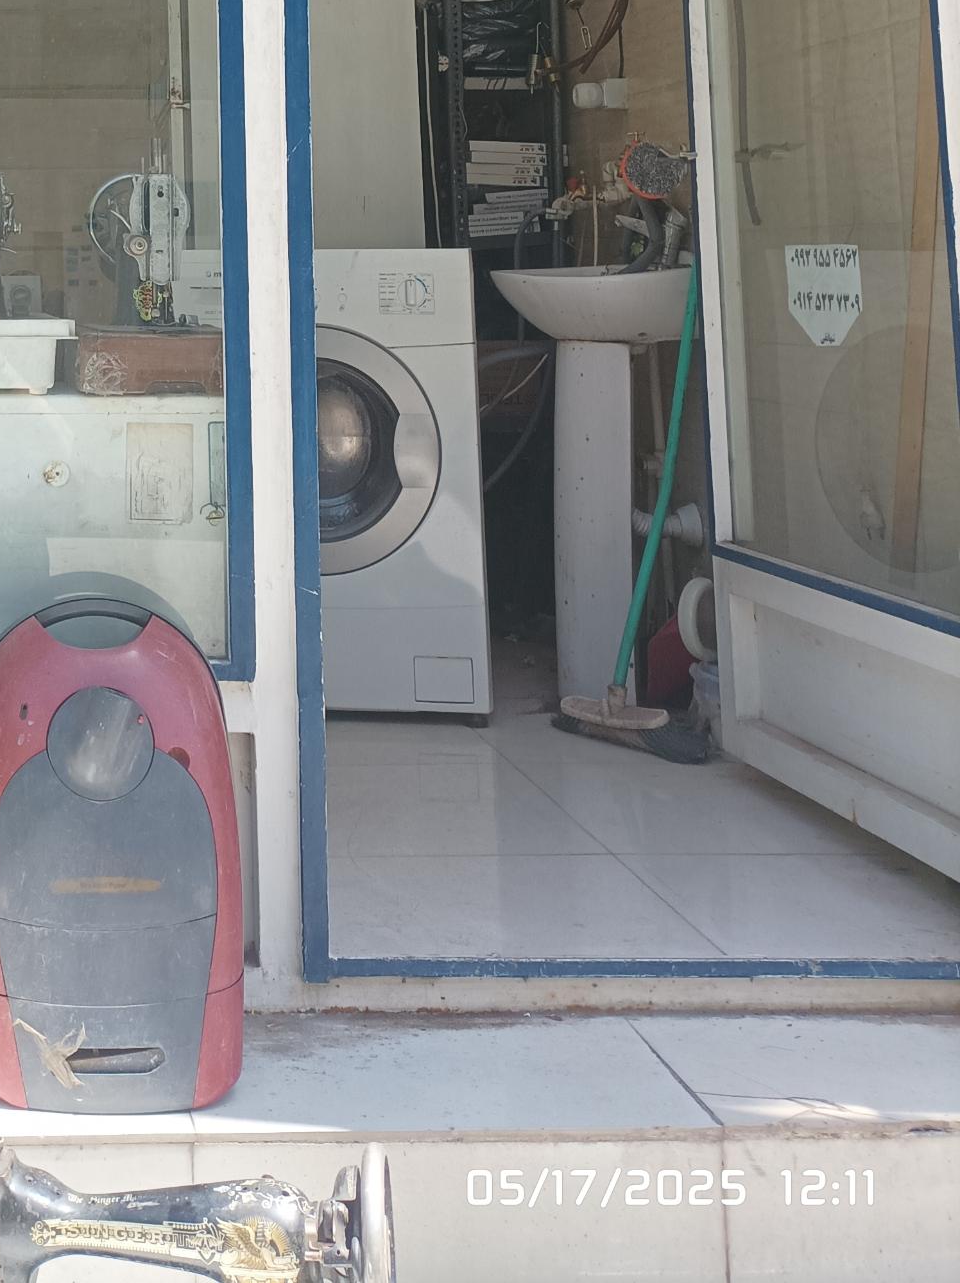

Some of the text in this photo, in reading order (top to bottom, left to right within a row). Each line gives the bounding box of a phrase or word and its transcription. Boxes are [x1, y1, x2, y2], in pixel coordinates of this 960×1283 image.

[813, 248, 831, 268] ۹۵۵
[793, 291, 813, 310] ۰۹۱۴
[66, 1223, 165, 1245] SINGER
